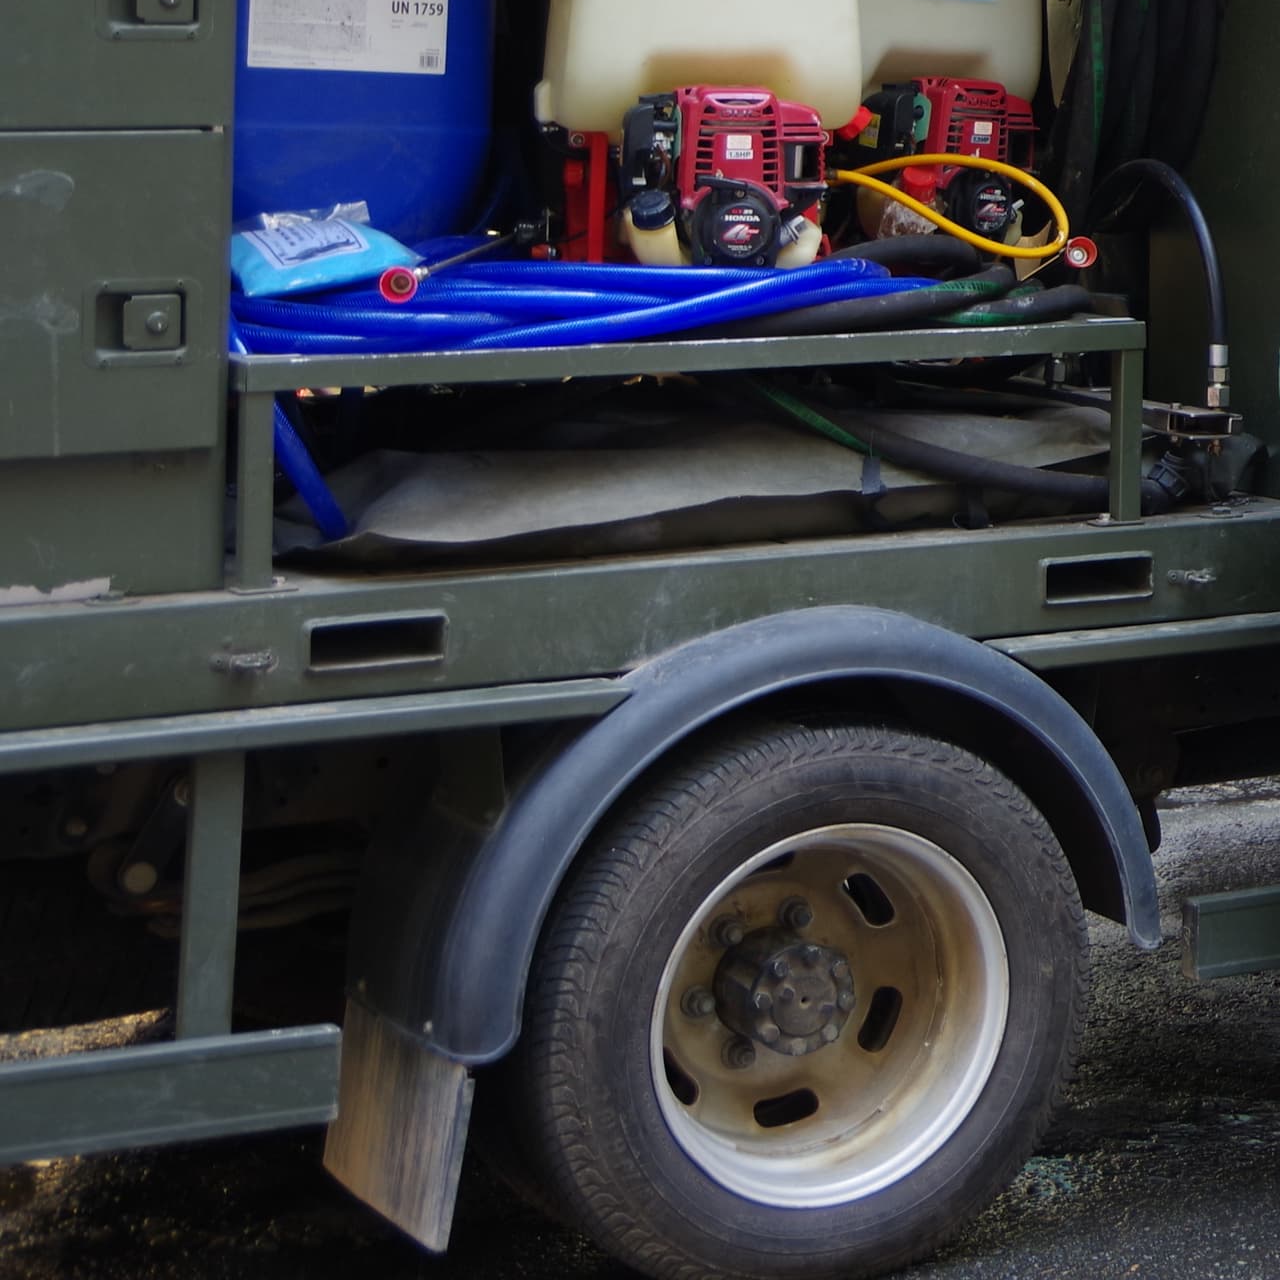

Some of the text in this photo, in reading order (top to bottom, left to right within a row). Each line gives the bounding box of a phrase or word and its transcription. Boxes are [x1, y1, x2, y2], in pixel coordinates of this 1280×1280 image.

[392, 0, 445, 17] UN 1759
[724, 214, 760, 223] HONDA
